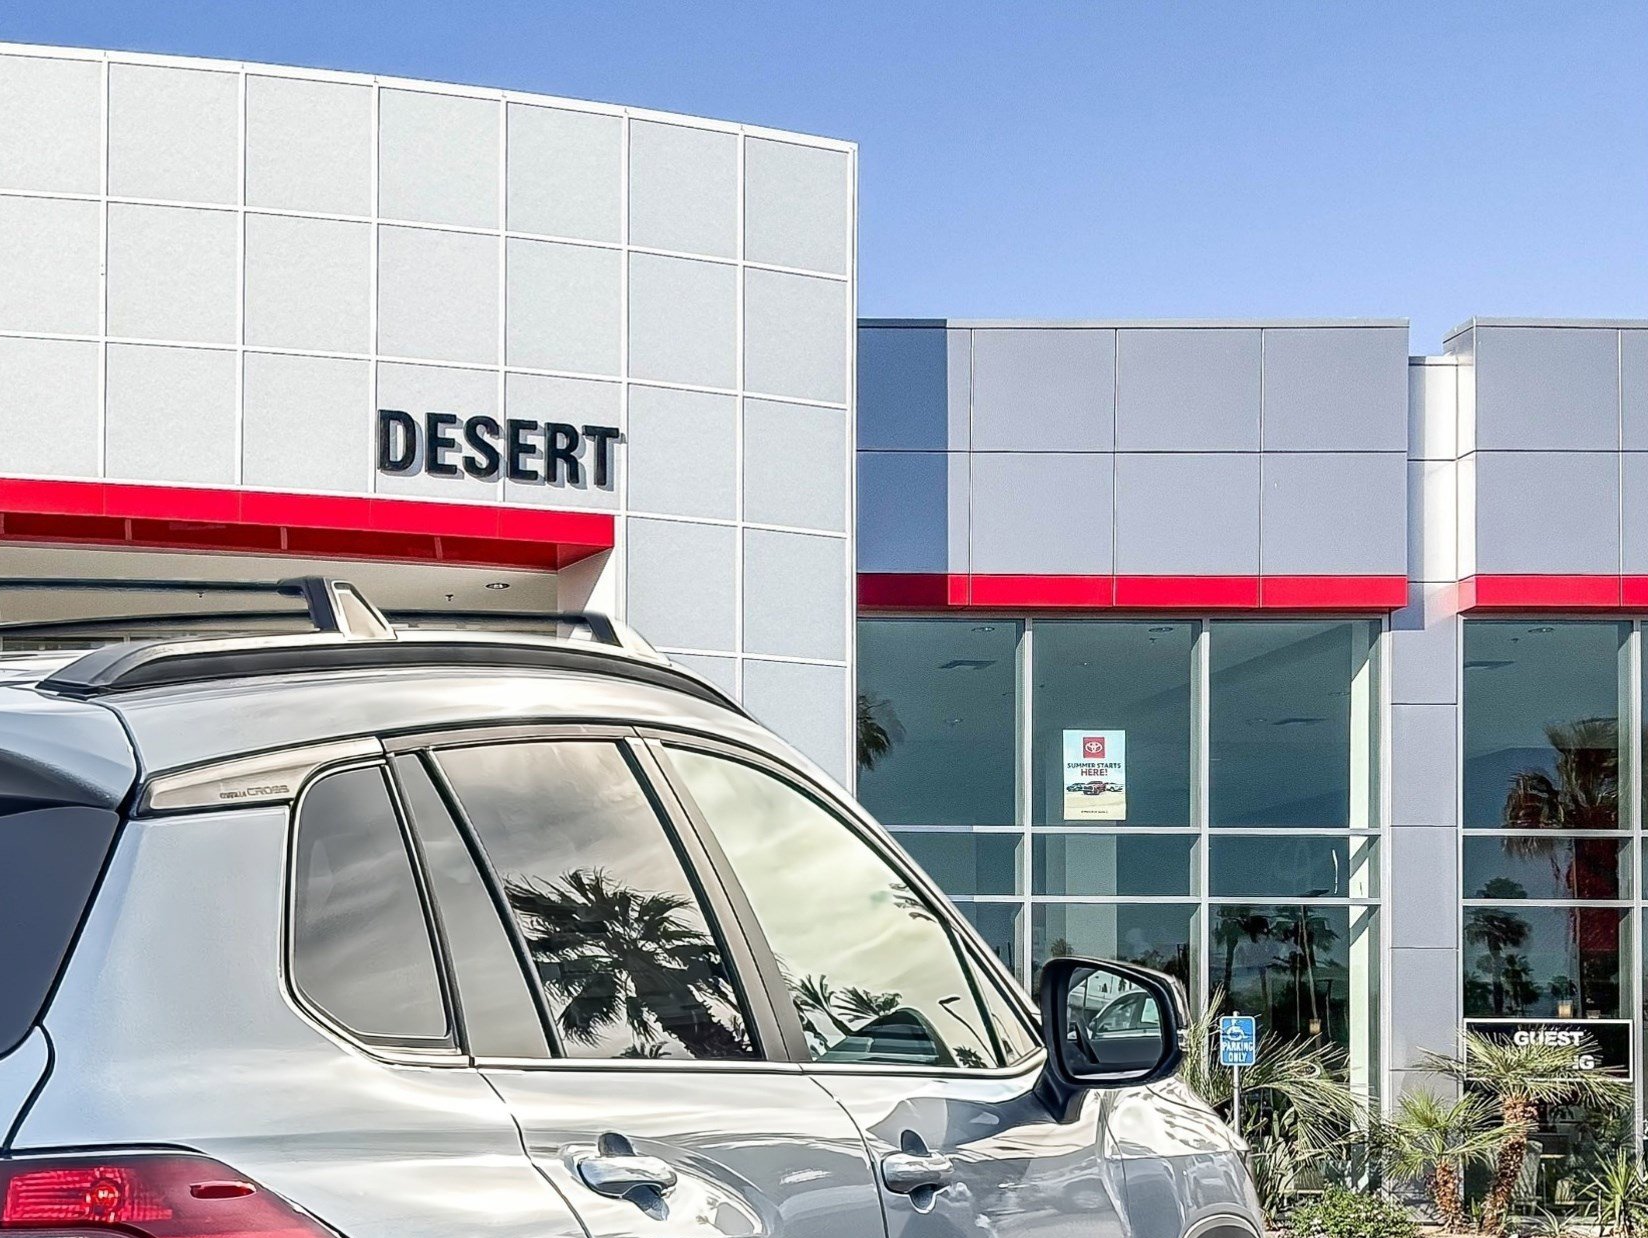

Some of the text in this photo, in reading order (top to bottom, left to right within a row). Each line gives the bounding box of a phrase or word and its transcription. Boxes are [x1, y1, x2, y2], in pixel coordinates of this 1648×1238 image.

[377, 408, 622, 488] DESERT
[1080, 768, 1108, 777] HERE!
[247, 785, 290, 796] CROSS
[1513, 1030, 1584, 1047] GUEST
[1222, 1040, 1254, 1052] PARKING
[1228, 1050, 1247, 1063] ONLY
